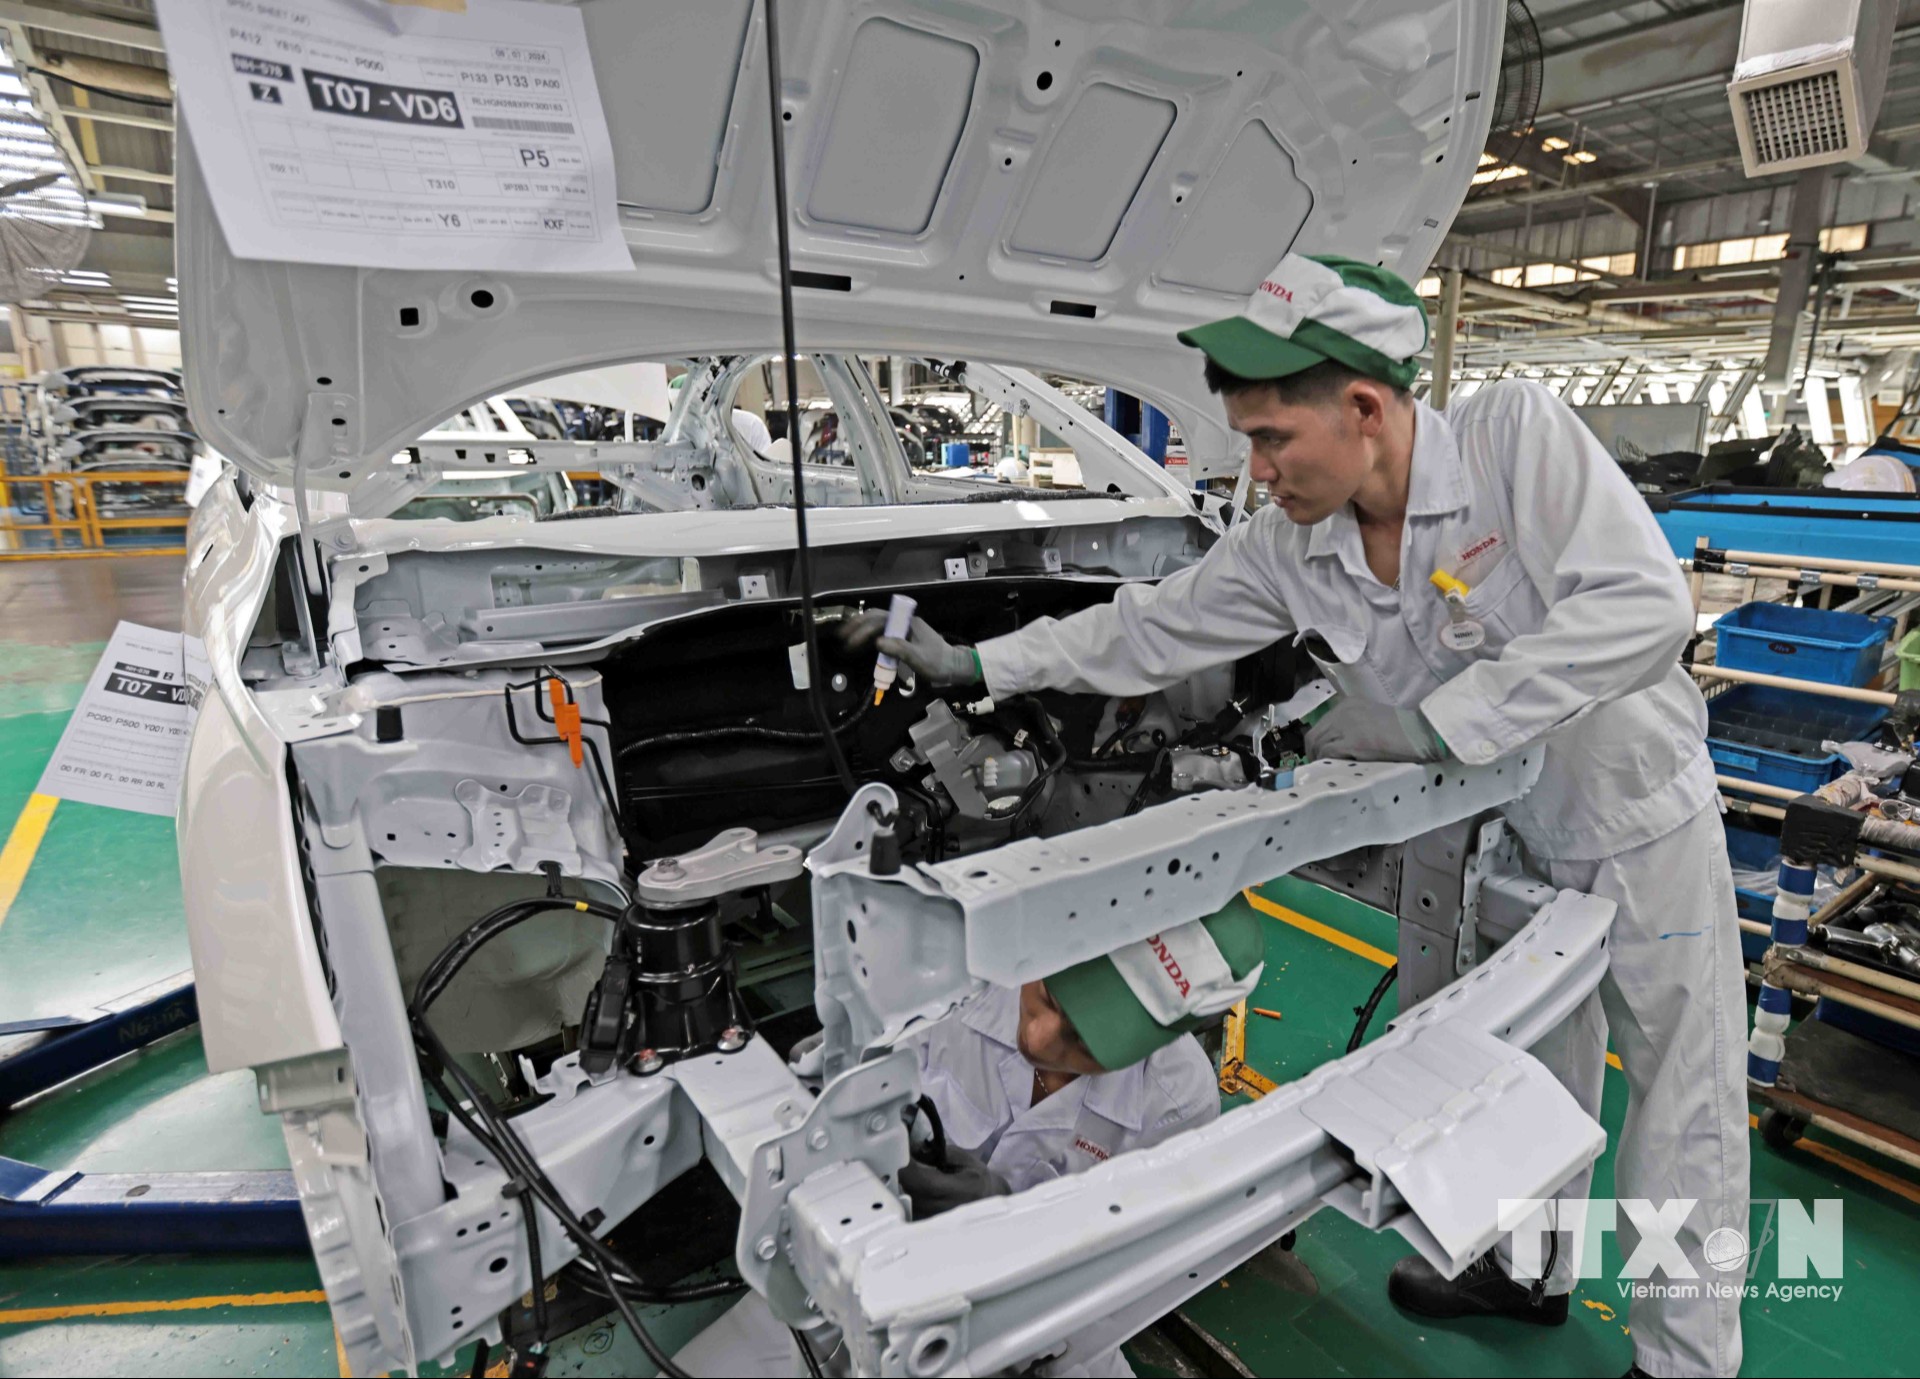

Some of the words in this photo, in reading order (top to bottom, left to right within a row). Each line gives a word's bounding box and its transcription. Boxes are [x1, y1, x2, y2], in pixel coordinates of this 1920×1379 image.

[461, 71, 489, 84] P133
[494, 73, 529, 88] P133
[520, 148, 550, 168] P5
[427, 178, 456, 190] T310
[438, 213, 462, 228] Y6
[543, 218, 565, 230] KXF
[1461, 536, 1498, 561] HONDA
[1146, 934, 1191, 998] ONDA
